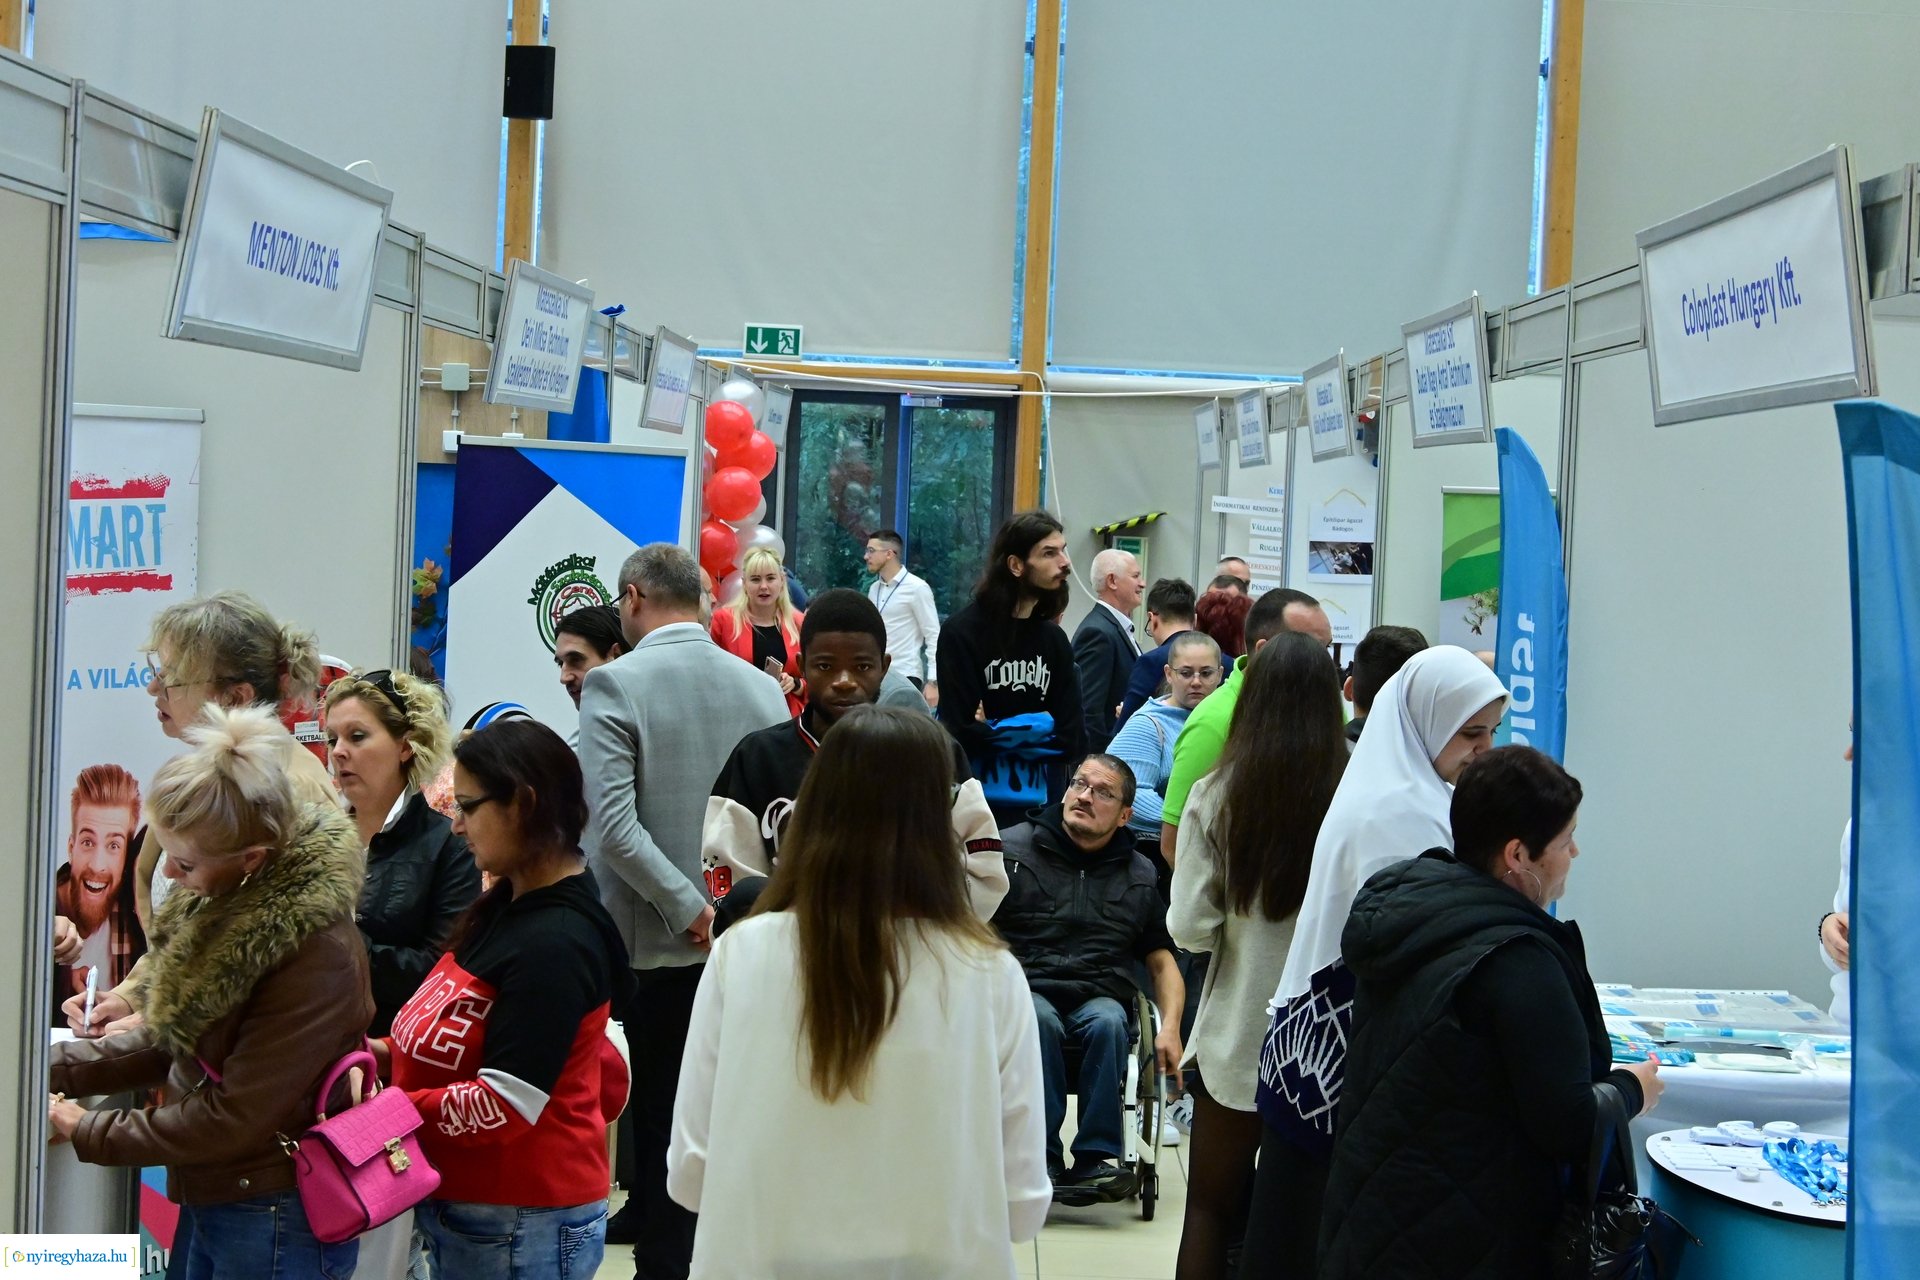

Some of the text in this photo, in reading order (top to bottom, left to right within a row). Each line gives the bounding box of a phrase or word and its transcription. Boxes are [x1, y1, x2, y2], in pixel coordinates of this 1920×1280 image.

[247, 221, 339, 291] MENTON JOBS Kft.
[1682, 256, 1801, 342] Coloplast Hungary Kft.
[66, 503, 167, 571] MART
[527, 553, 596, 605] Mátészalkai
[1251, 583, 1274, 592] PÉNZÜ
[67, 662, 160, 690] A VILÁG
